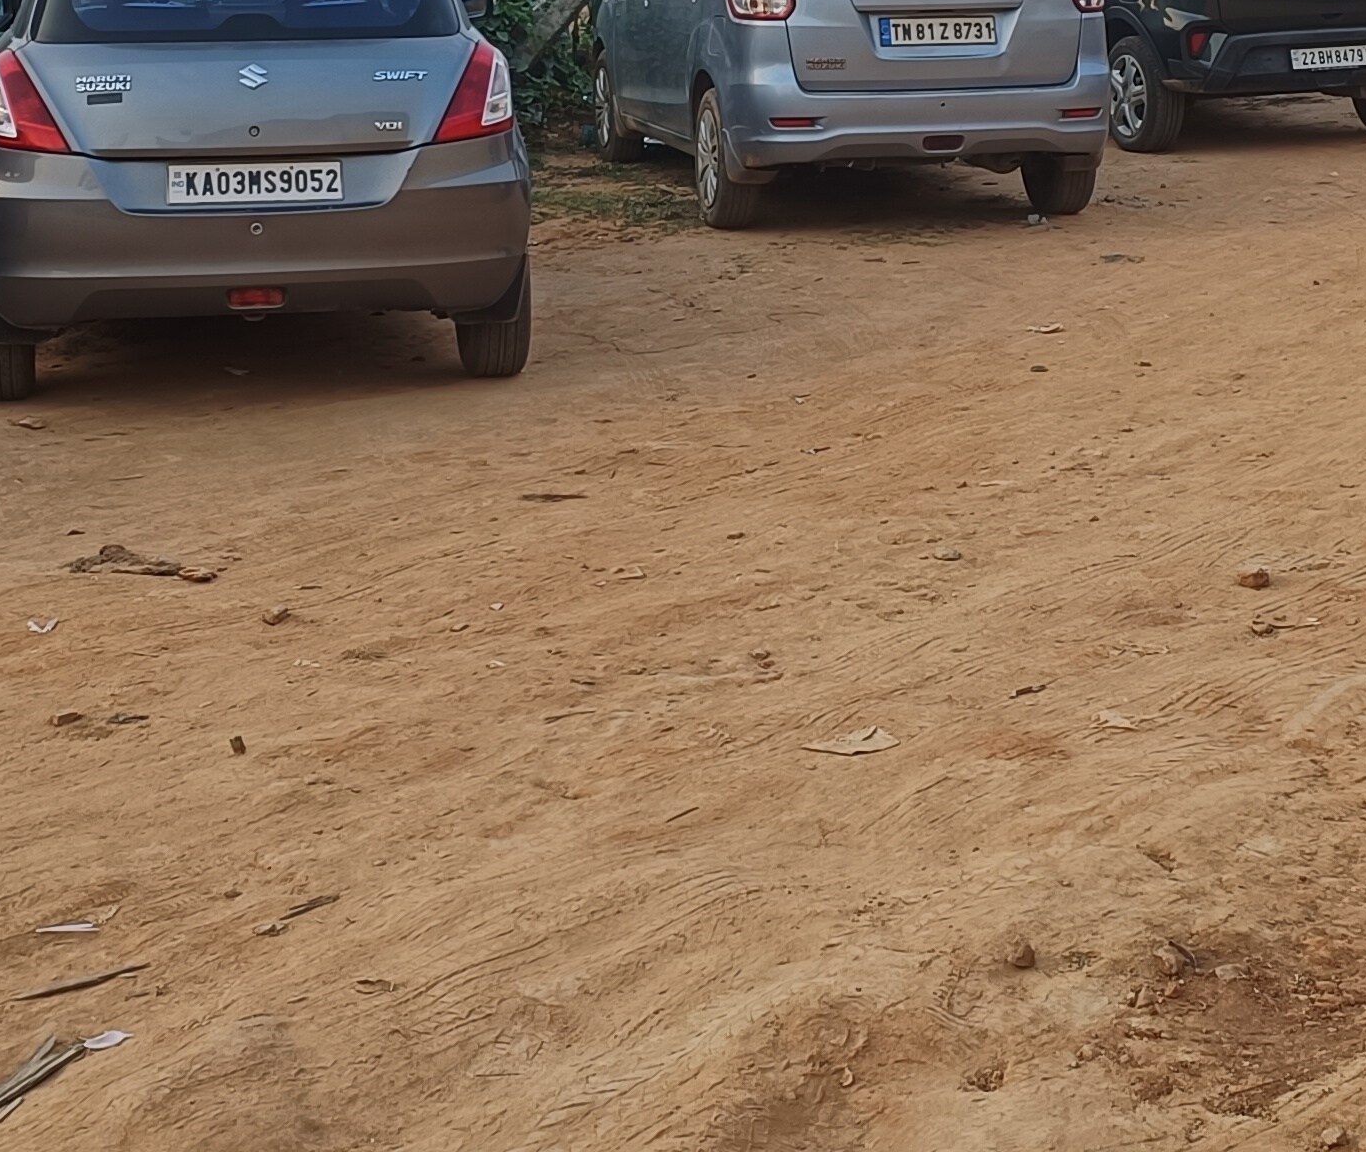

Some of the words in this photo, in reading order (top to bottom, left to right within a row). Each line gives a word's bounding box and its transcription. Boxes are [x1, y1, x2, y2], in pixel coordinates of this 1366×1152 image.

[892, 23, 912, 41] TN
[916, 23, 935, 41] 81
[939, 22, 950, 40] Z
[953, 22, 993, 40] 8731
[75, 74, 131, 83] MARUTI
[373, 70, 428, 80] SWIFT
[75, 81, 131, 92] SUZUKI
[185, 169, 339, 196] KA03MS9052
